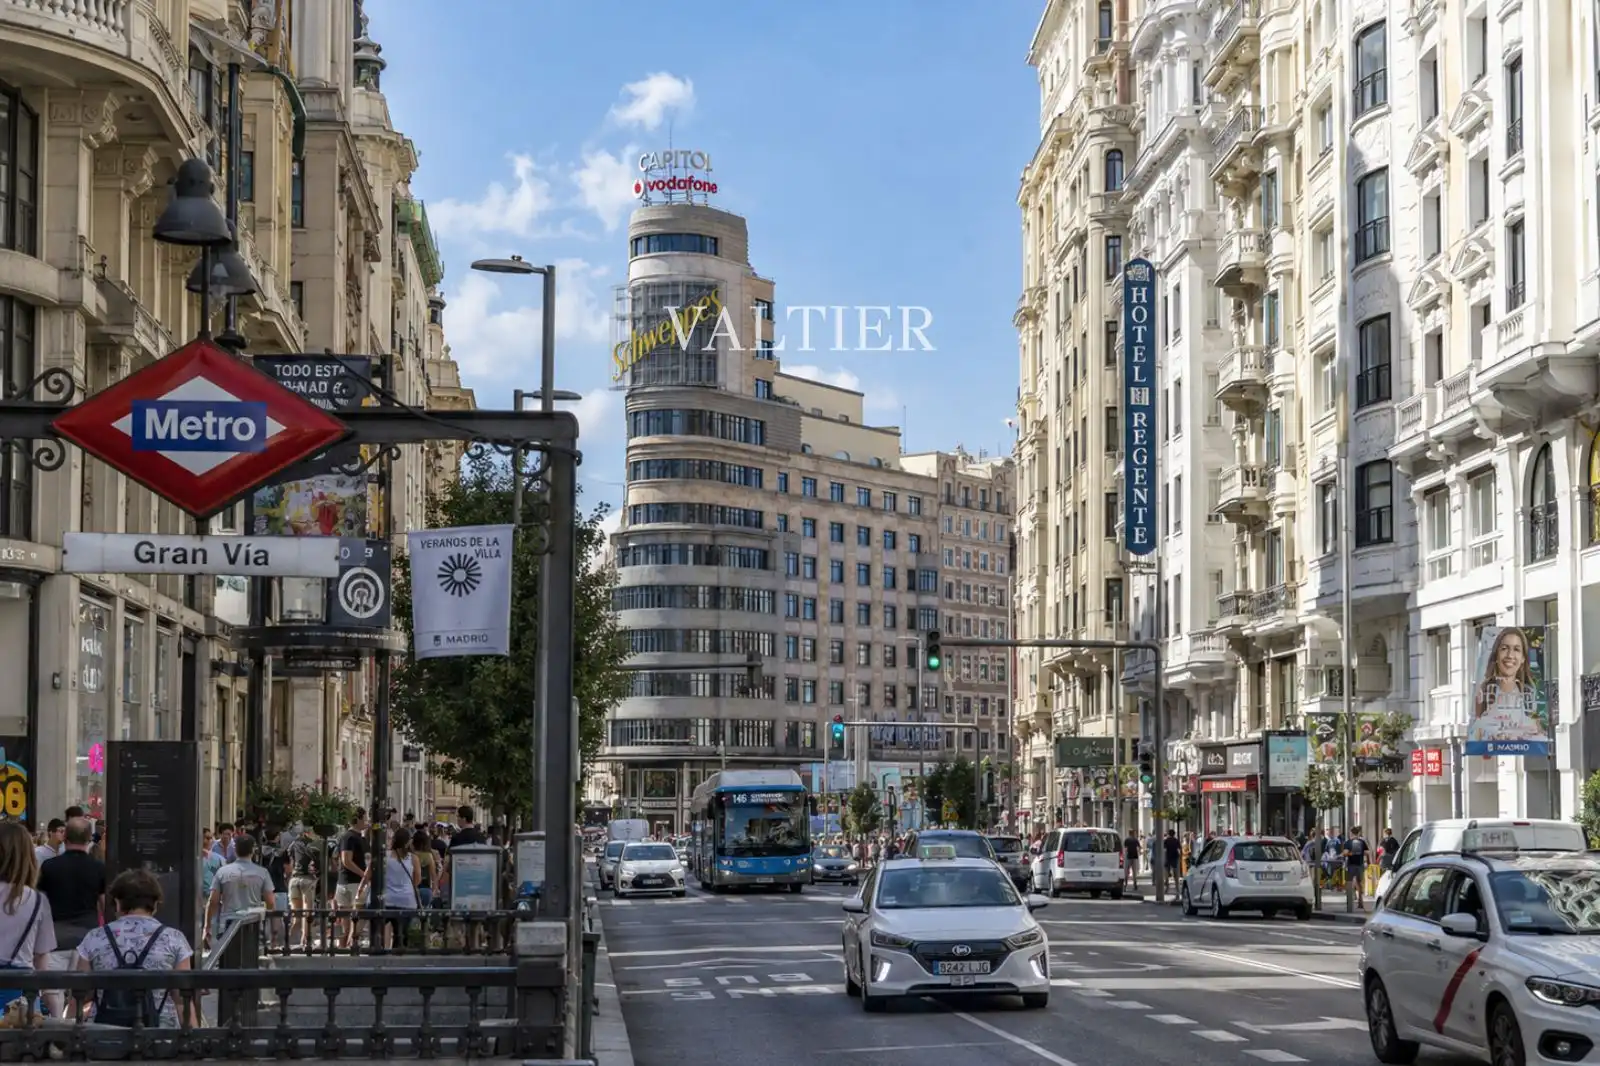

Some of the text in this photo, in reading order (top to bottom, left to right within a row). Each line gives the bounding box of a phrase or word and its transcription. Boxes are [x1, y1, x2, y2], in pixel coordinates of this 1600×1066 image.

[639, 150, 713, 173] CAPITOL
[647, 175, 718, 194] vodafone
[274, 364, 311, 377] TODO
[144, 407, 257, 442] Metro
[1130, 287, 1148, 544] HOTEL REGENTE
[133, 540, 270, 566] Gran Vía
[420, 536, 501, 550] VERANOS DE LA
[445, 633, 490, 644] MADRID
